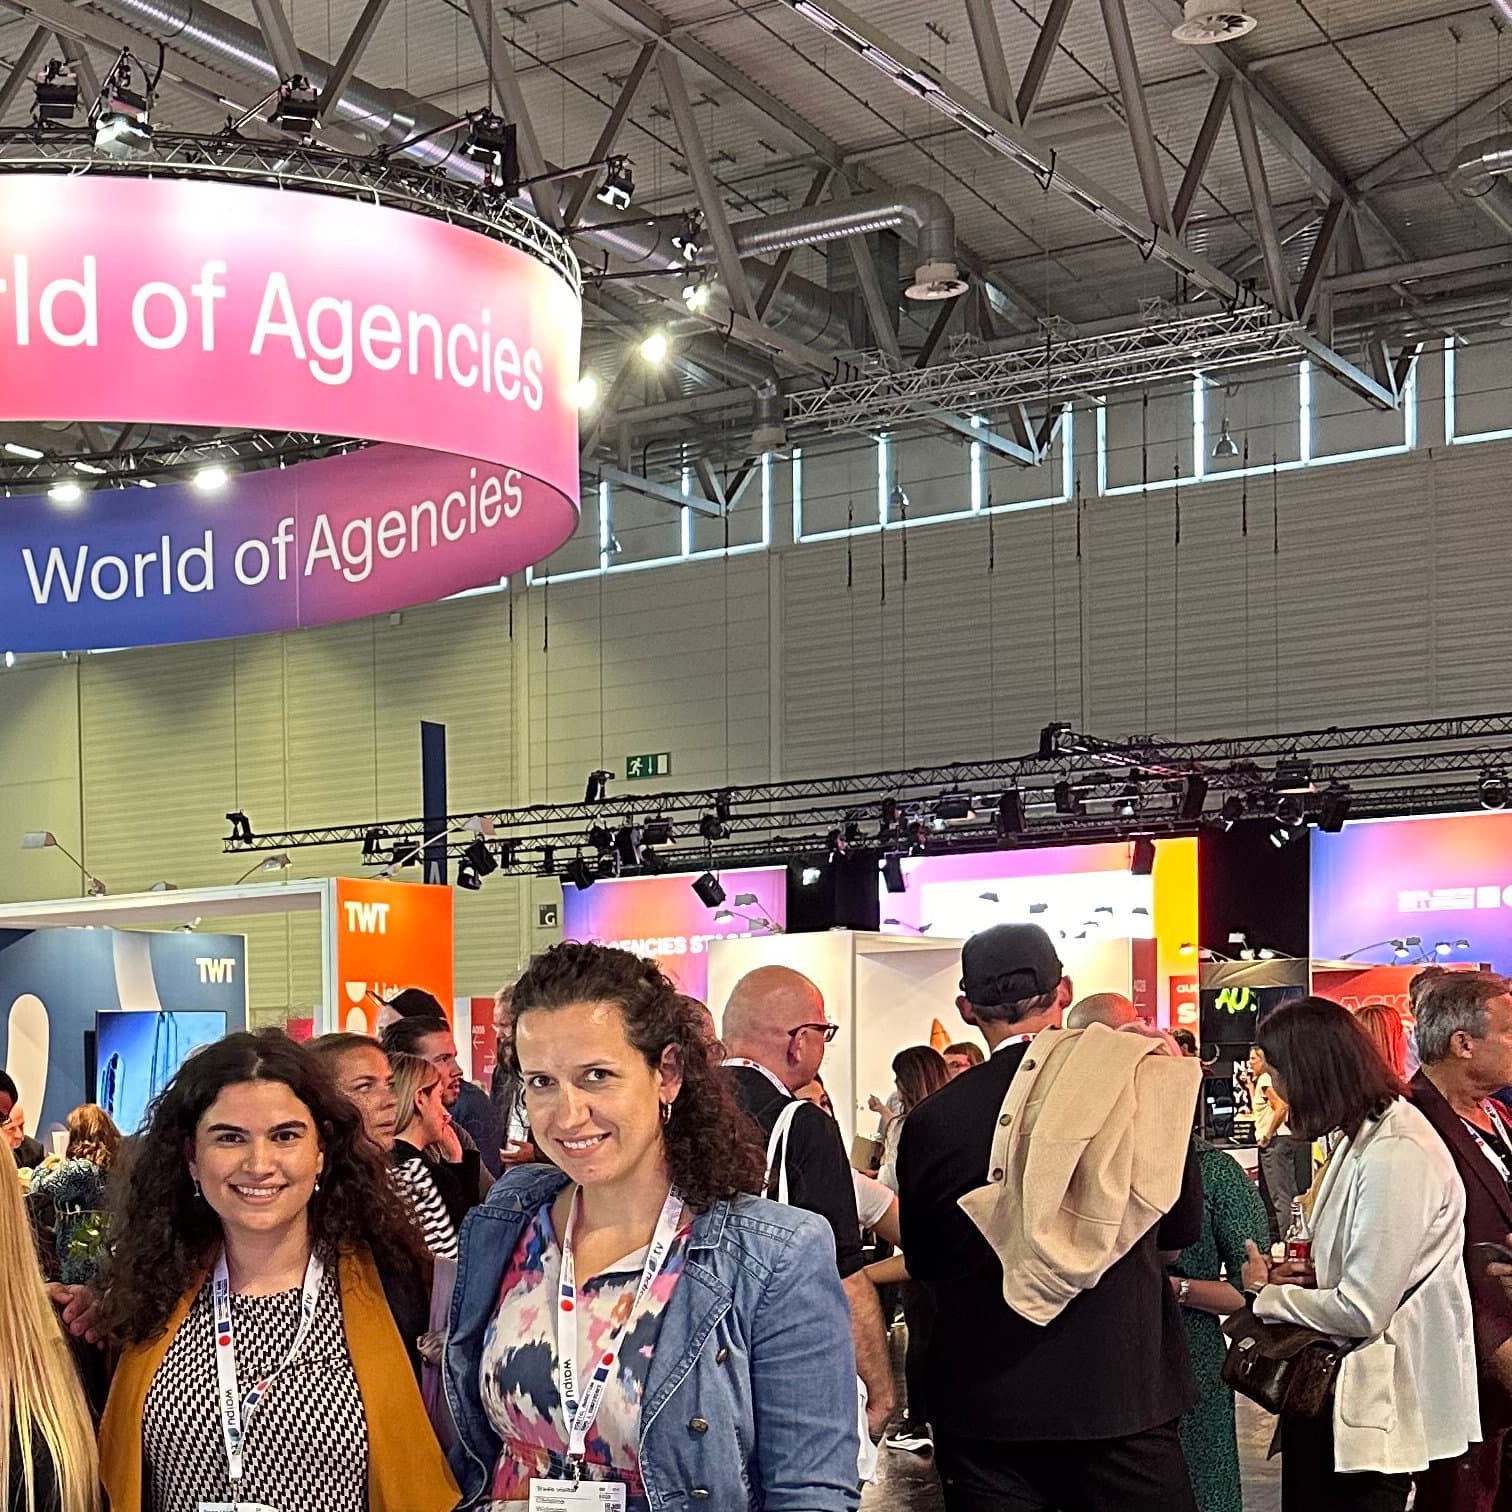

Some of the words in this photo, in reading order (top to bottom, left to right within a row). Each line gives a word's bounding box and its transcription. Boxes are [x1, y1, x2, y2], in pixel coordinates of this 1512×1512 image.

[130, 260, 227, 352] of
[249, 271, 544, 412] Agencies
[22, 530, 214, 604] World
[234, 518, 297, 582] of
[302, 467, 523, 583] Agencies
[344, 901, 390, 934] TWT
[545, 912, 555, 926] G
[195, 957, 236, 984] TWT
[562, 1358, 574, 1398] waipu
[222, 1388, 236, 1427] waipu
